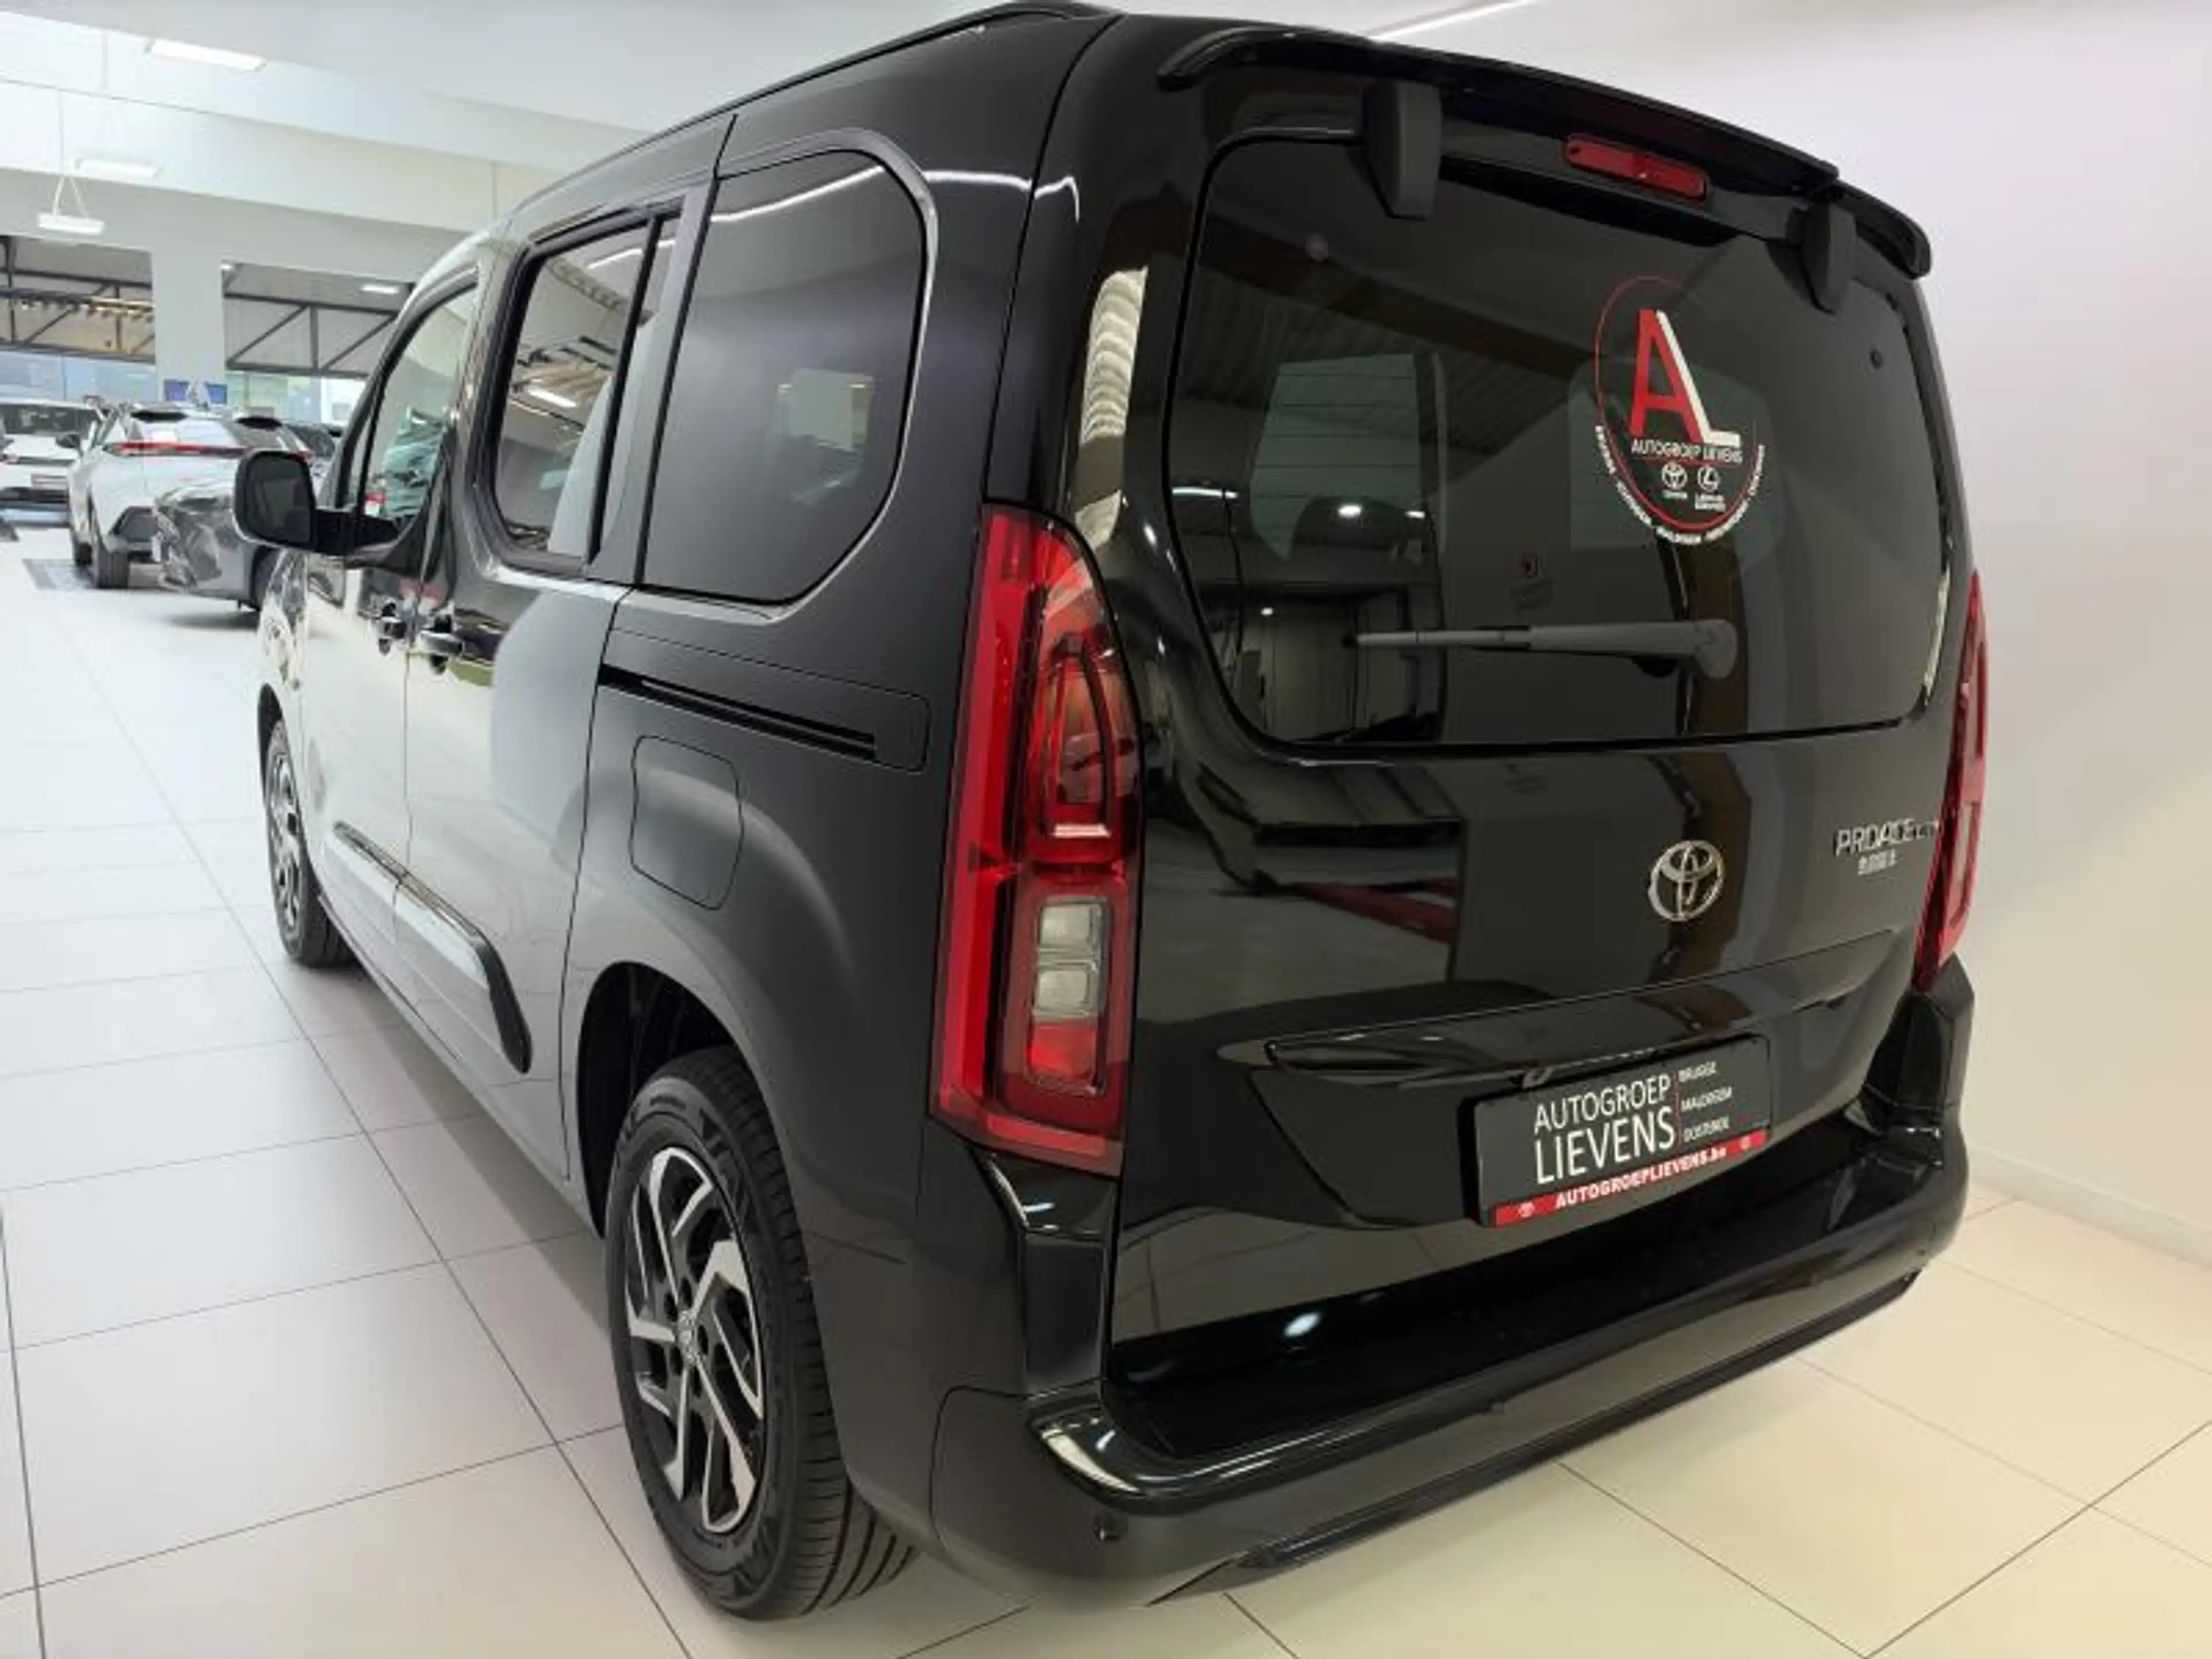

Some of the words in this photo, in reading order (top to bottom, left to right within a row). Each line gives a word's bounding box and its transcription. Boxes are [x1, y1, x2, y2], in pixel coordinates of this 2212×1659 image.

[1533, 1073, 1672, 1135] AUTOGROEP
[1535, 1106, 1676, 1185] LIEVENS
[1555, 1147, 1727, 1210] AUTOGROEPLIEVENS.be
